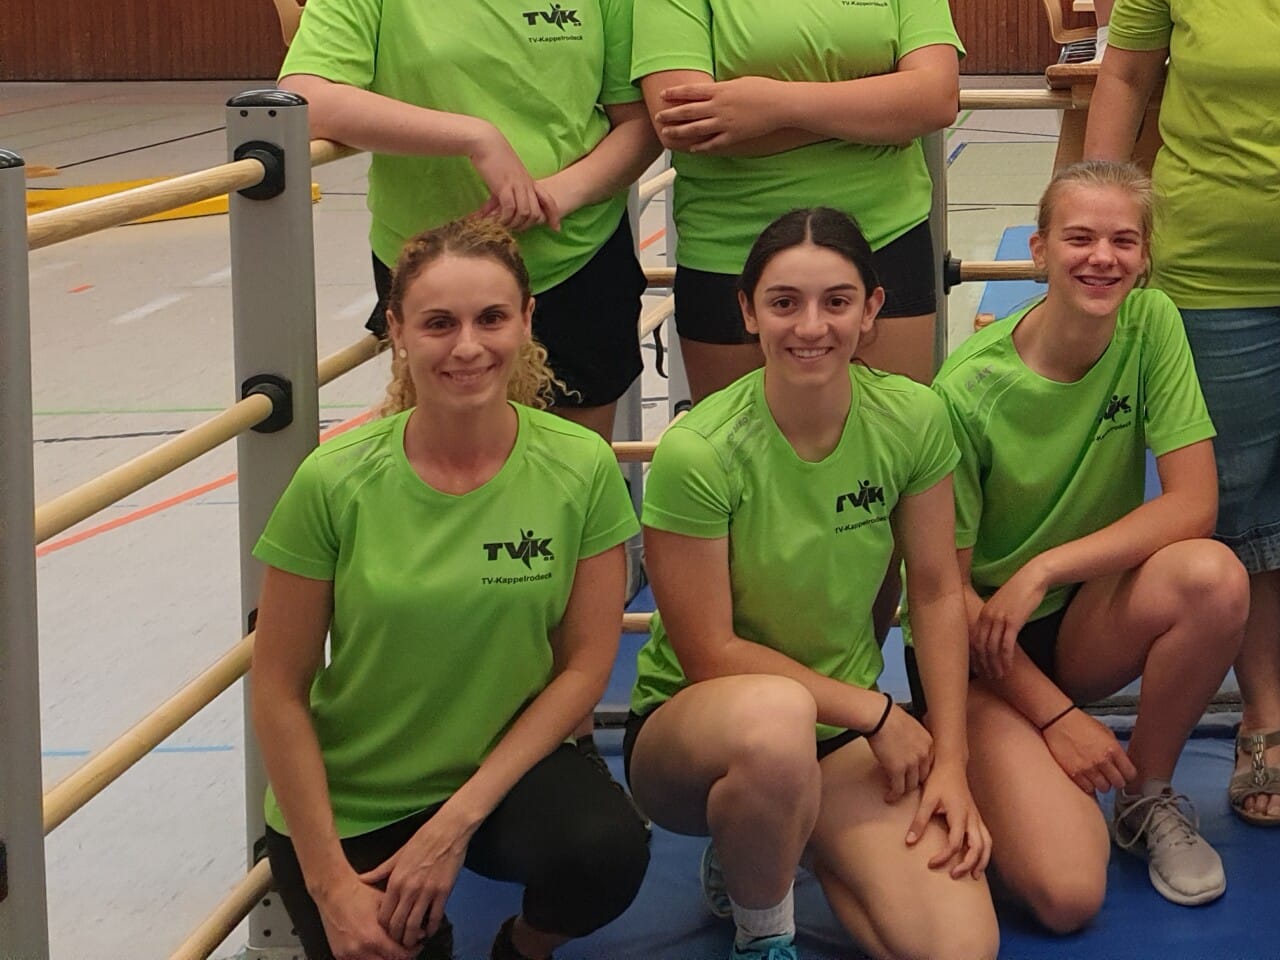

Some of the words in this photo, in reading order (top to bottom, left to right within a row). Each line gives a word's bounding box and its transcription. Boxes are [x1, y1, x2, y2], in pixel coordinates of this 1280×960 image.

[522, 7, 581, 27] TVK
[482, 535, 554, 562] TVK
[482, 571, 552, 584] TV-Kappelrodeck
